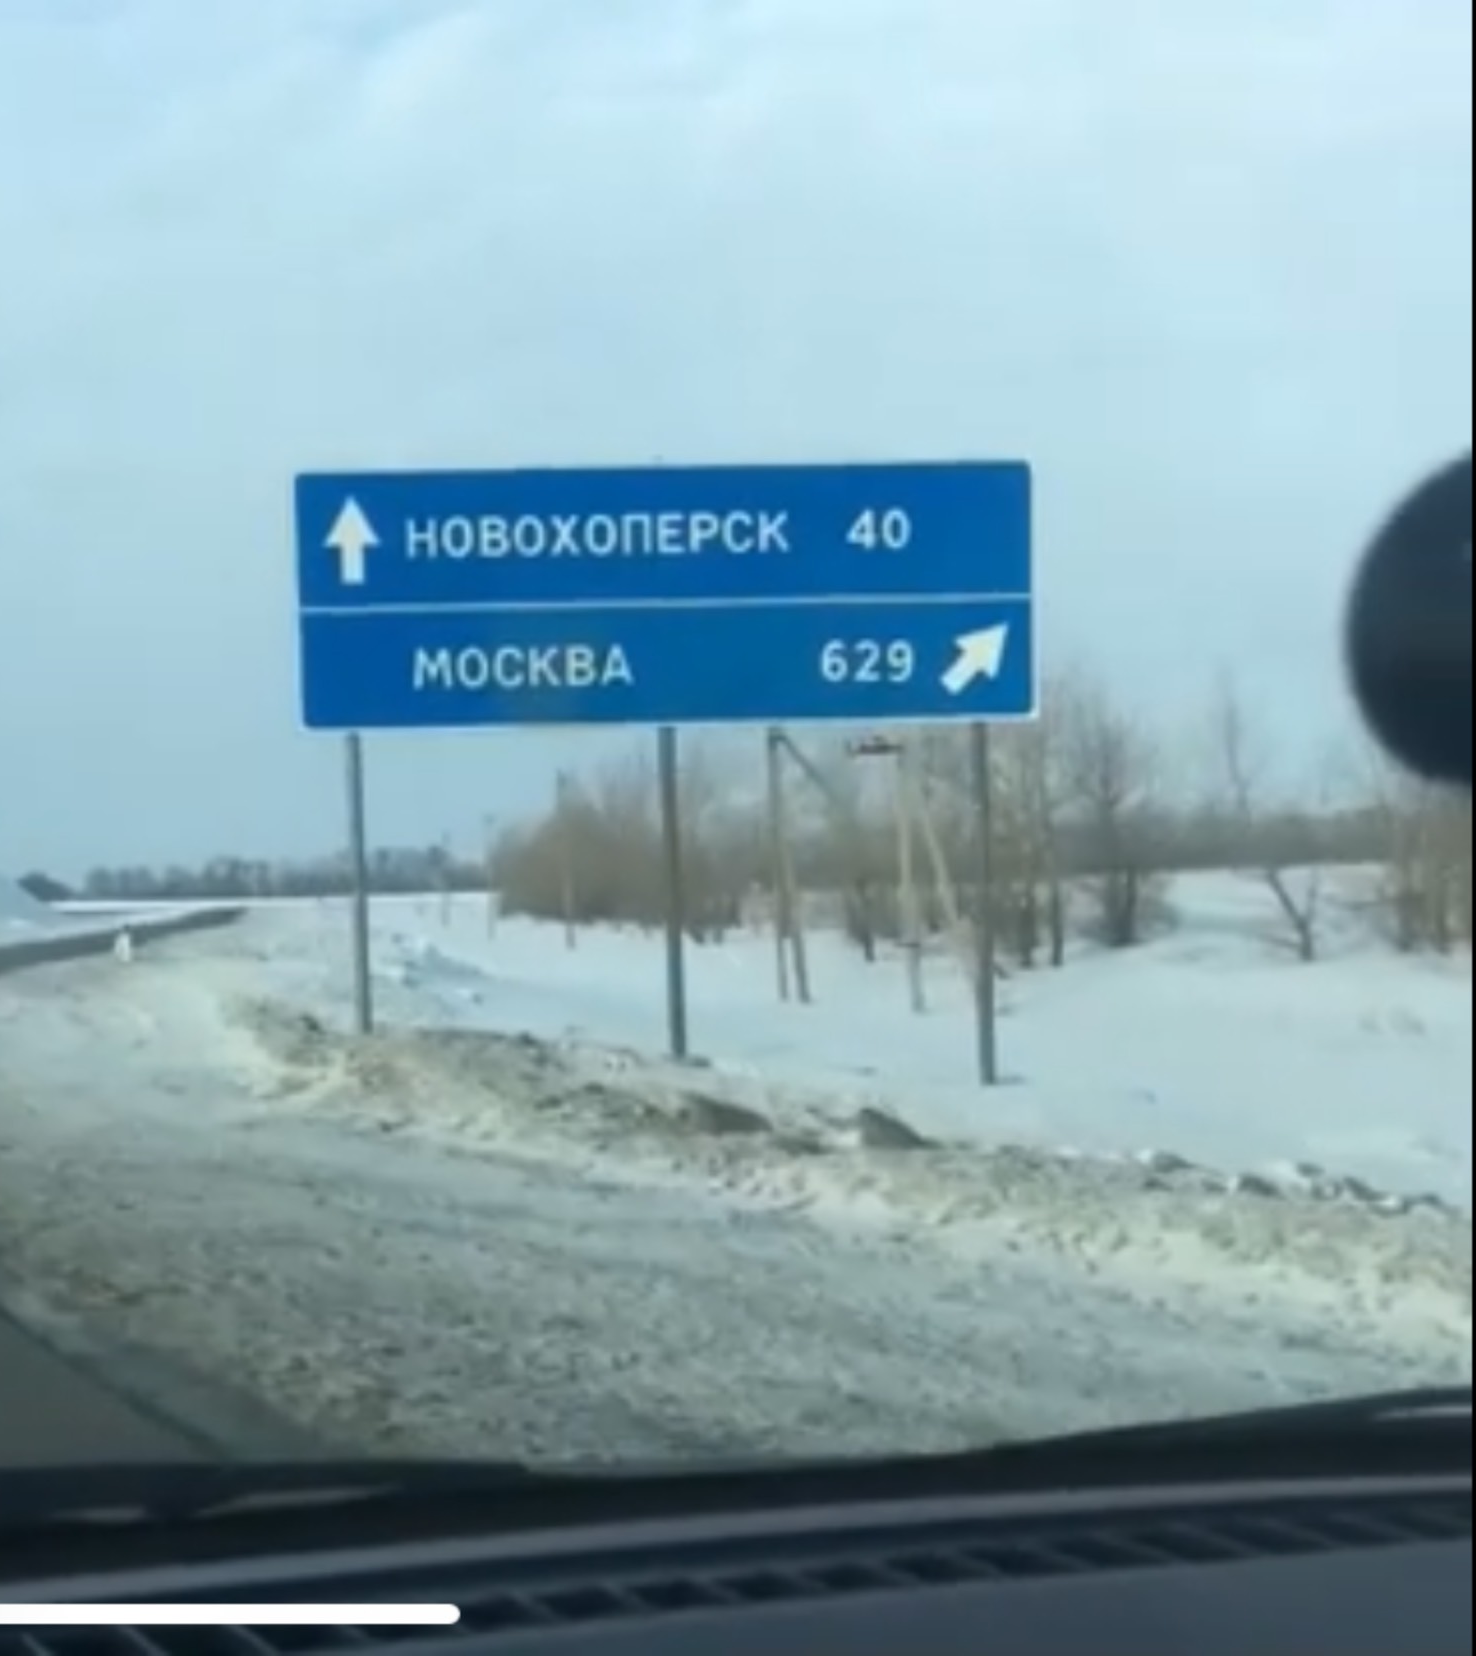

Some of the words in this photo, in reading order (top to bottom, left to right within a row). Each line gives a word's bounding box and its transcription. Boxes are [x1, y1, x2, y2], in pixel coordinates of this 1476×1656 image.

[406, 511, 791, 558] НОВОХОПЕРСК
[846, 508, 912, 550] 40
[412, 643, 635, 689] МОСКВА
[820, 639, 915, 684] 629
